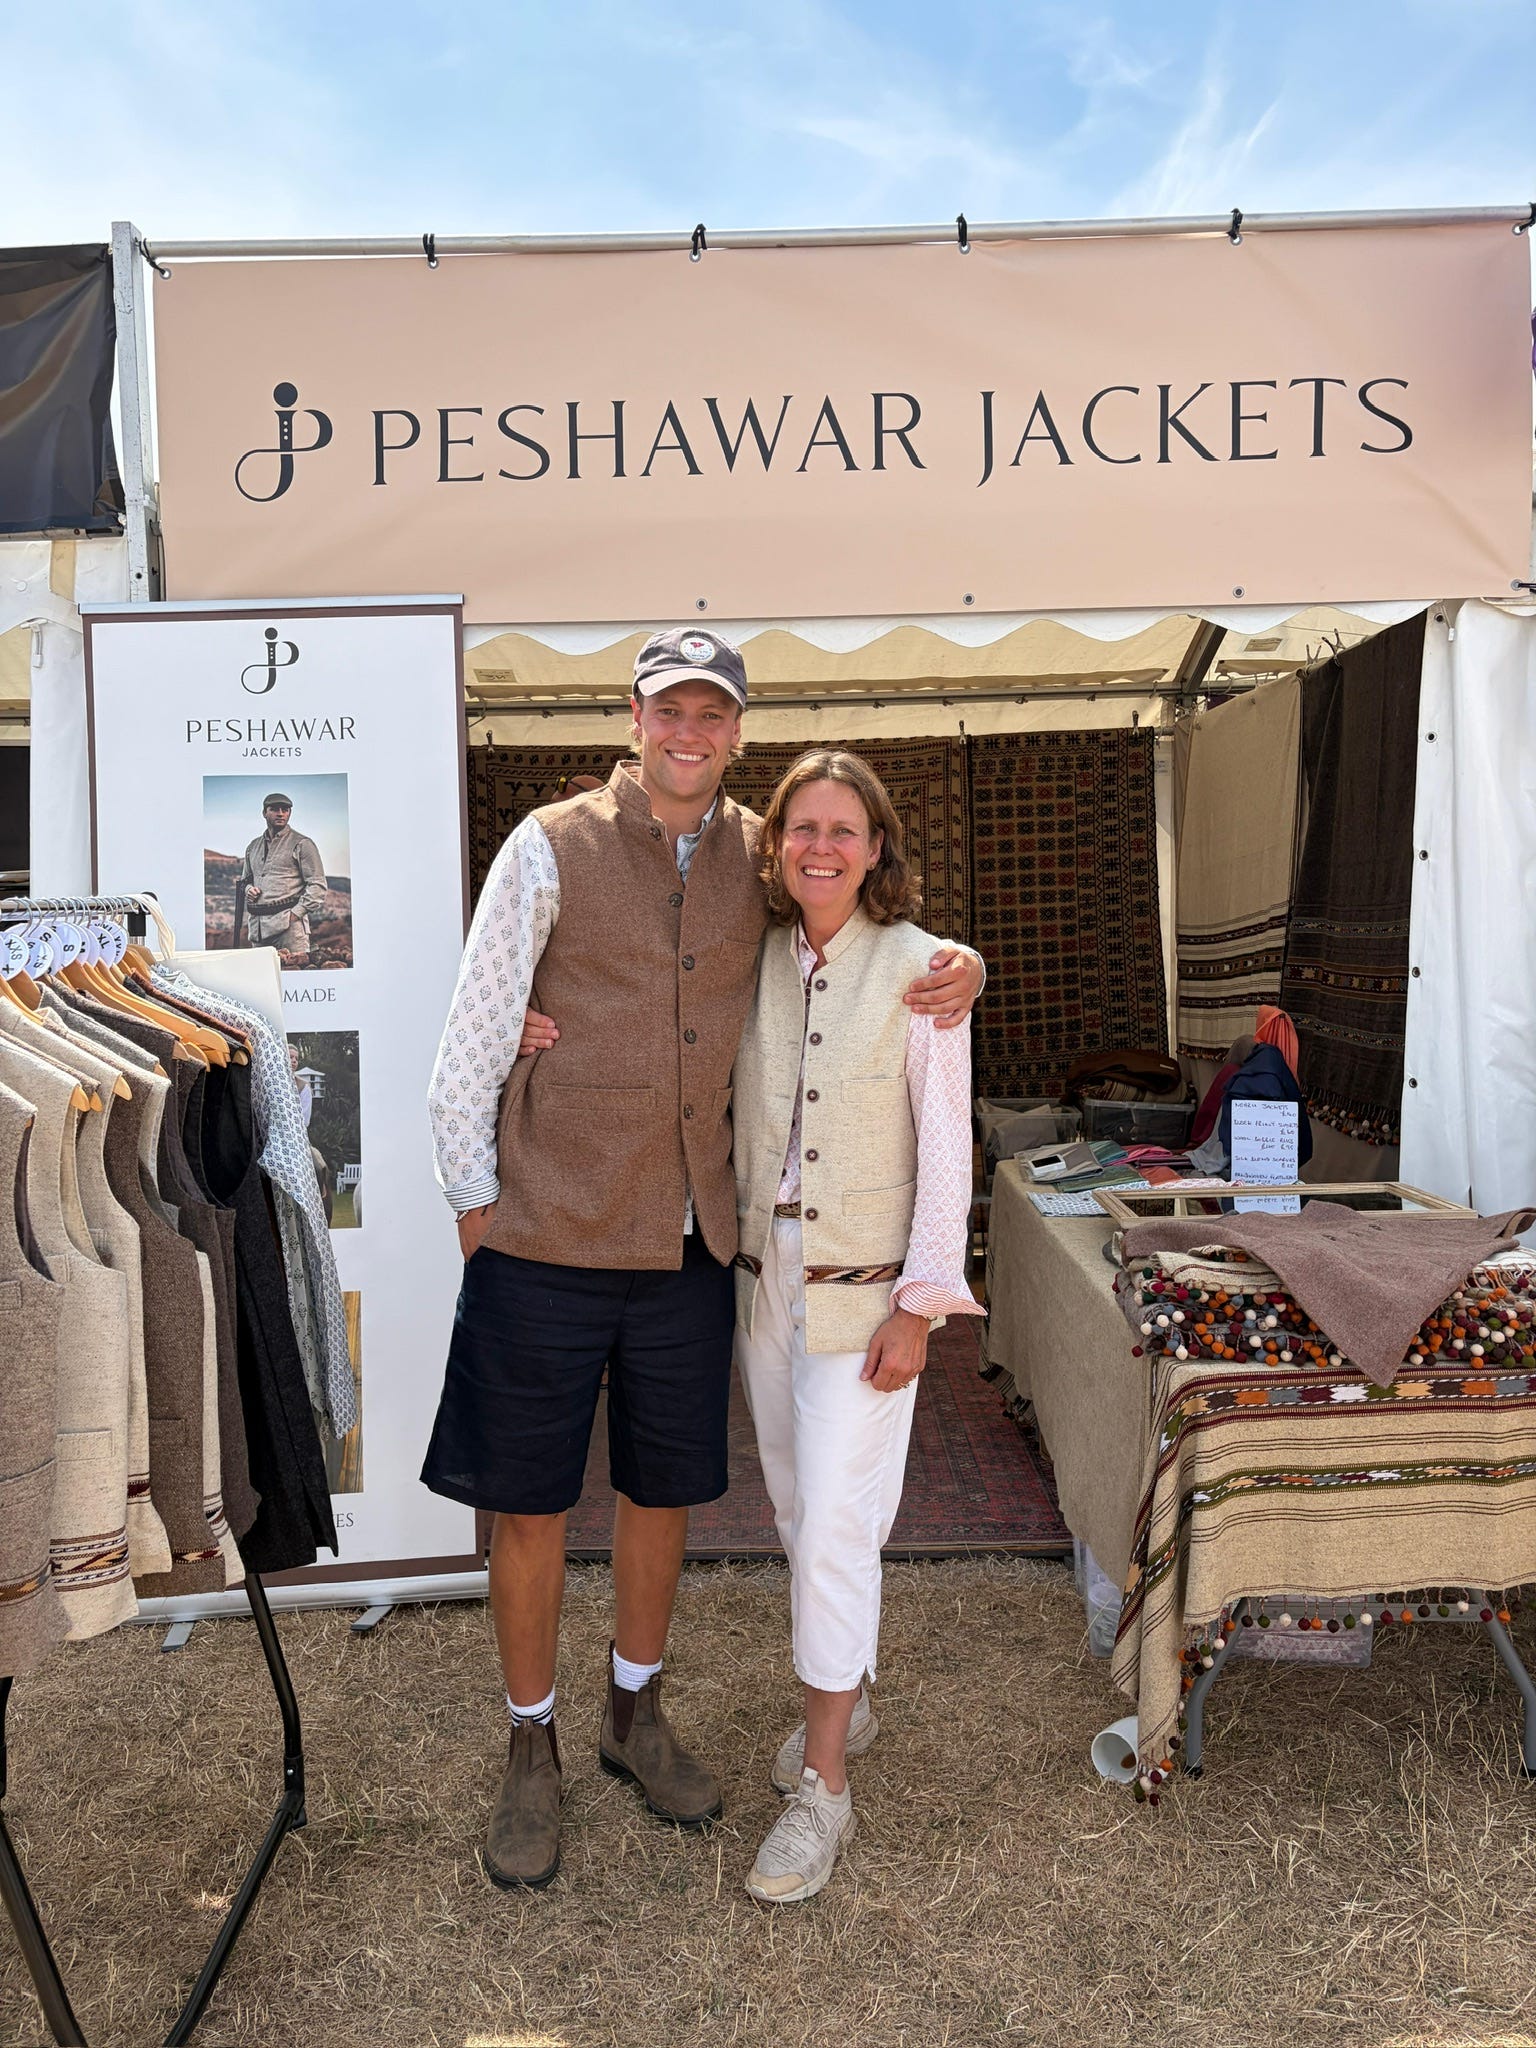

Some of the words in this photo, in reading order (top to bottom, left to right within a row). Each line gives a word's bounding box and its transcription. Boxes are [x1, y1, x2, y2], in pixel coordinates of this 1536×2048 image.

[371, 392, 927, 486] PESHAWAR
[976, 377, 1414, 488] JACKETS
[186, 716, 356, 743] PESHAWAR
[242, 747, 302, 758] JACKETS
[5, 939, 23, 961] XXS
